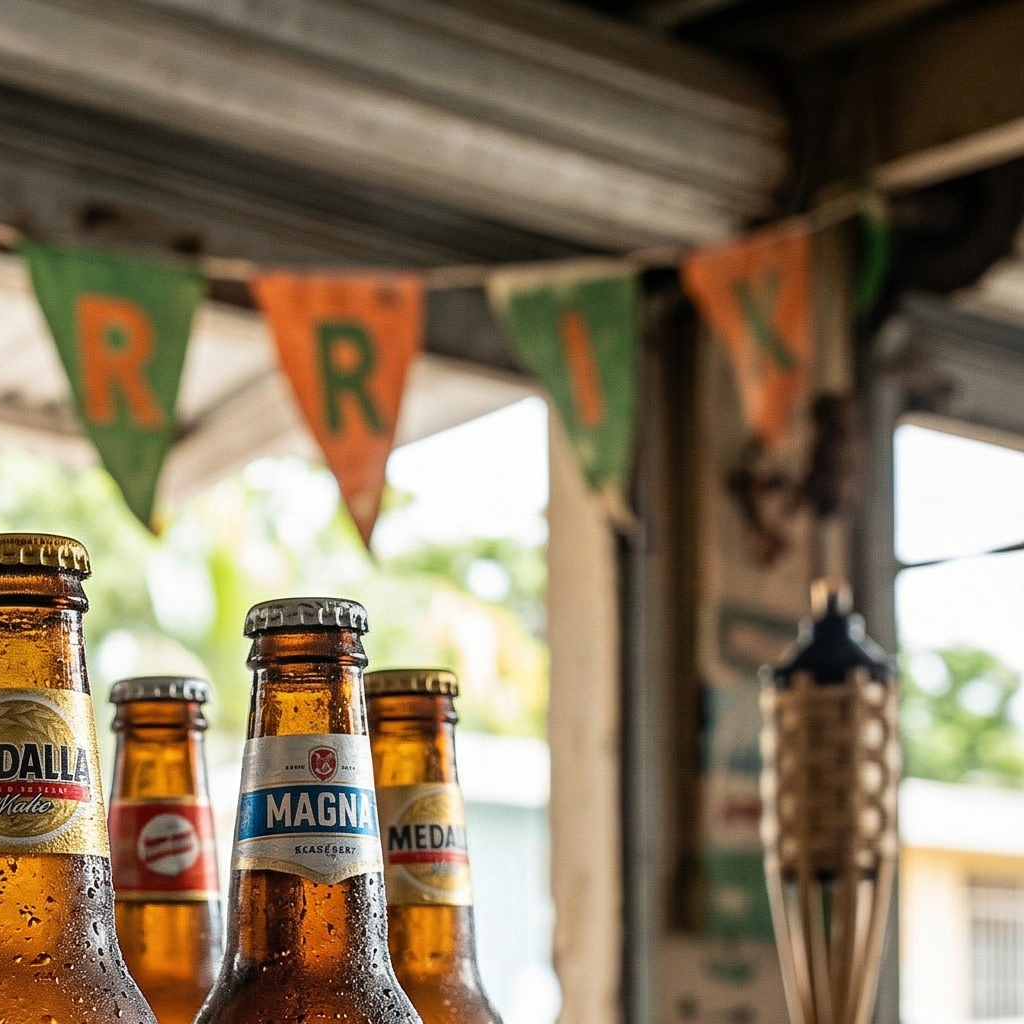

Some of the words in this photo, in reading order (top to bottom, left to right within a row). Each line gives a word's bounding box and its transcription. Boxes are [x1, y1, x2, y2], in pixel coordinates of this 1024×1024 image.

[79, 294, 164, 429] R
[314, 321, 388, 436] R
[266, 791, 374, 830] MAGNA
